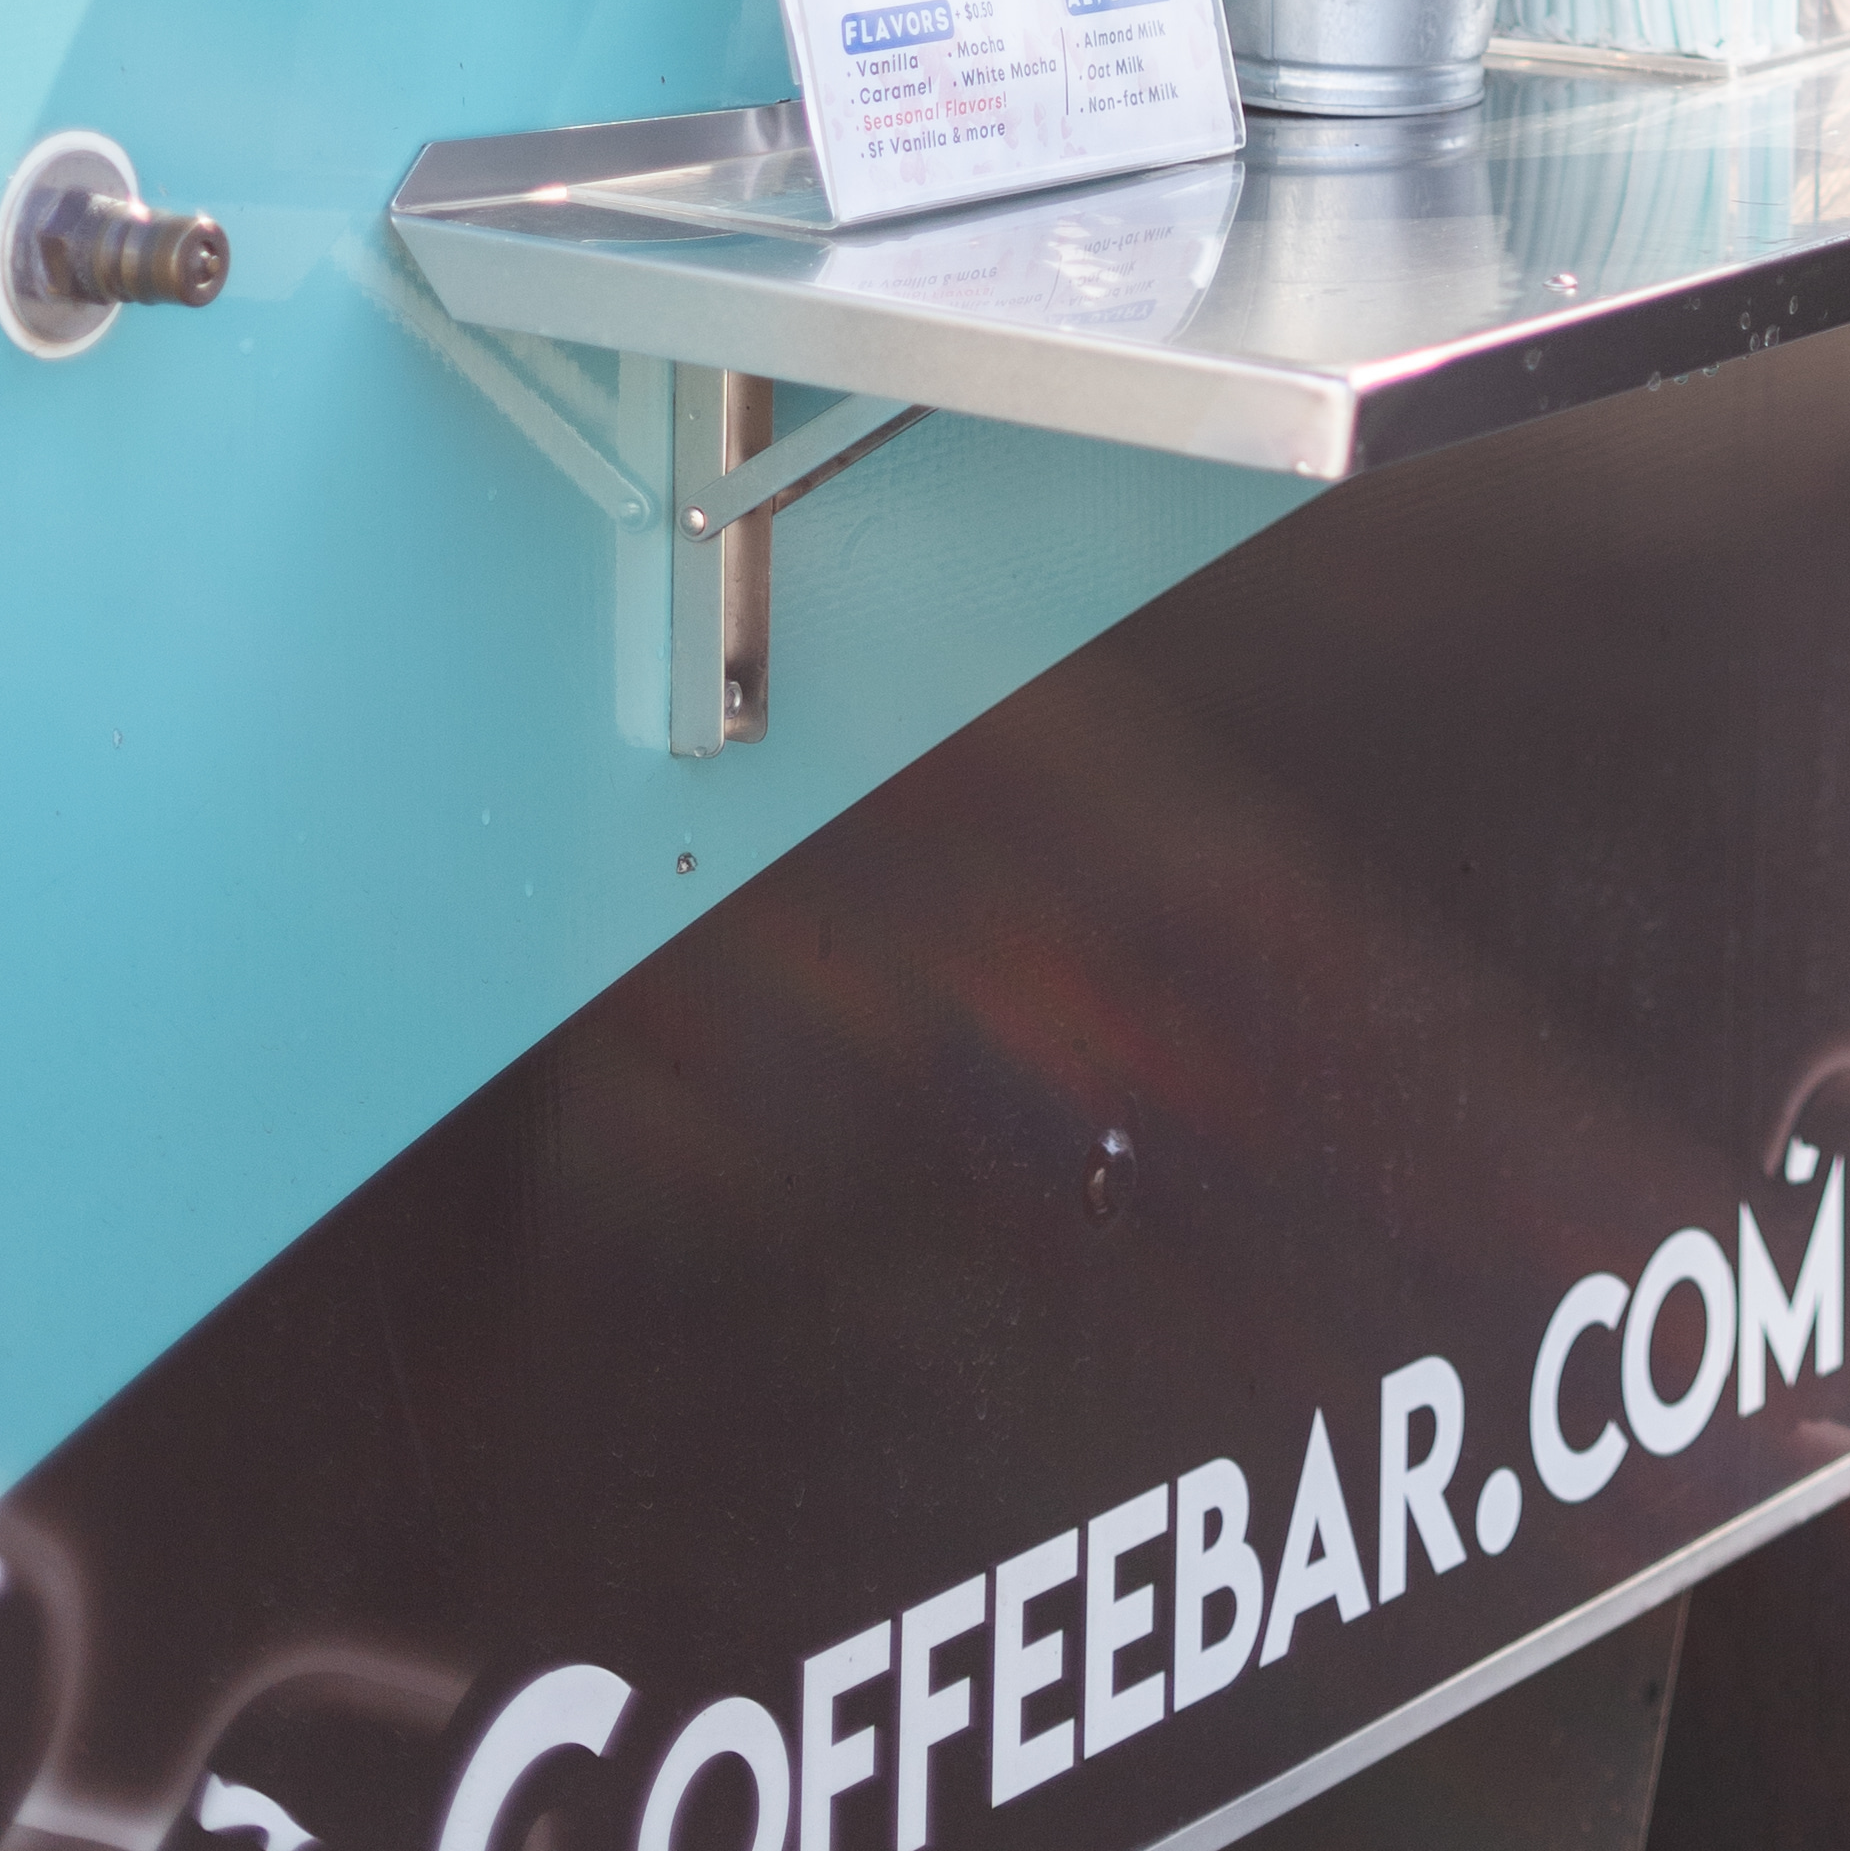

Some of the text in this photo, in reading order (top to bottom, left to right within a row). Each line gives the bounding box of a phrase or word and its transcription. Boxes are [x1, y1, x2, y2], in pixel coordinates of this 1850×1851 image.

[844, 0, 994, 47] FLAVORS $0.50
[1083, 18, 1167, 50] Almond Milk
[956, 37, 1006, 59] Mocha
[855, 53, 919, 78] Vanilla
[961, 56, 1057, 89] White Mocha
[1087, 54, 1145, 82] Oat Milk
[859, 76, 934, 106] Caramel
[1087, 82, 1180, 115] Non-fat Milk
[863, 90, 1008, 133] Seasonal Flavors!
[867, 121, 1007, 160] SF Vanilla & more
